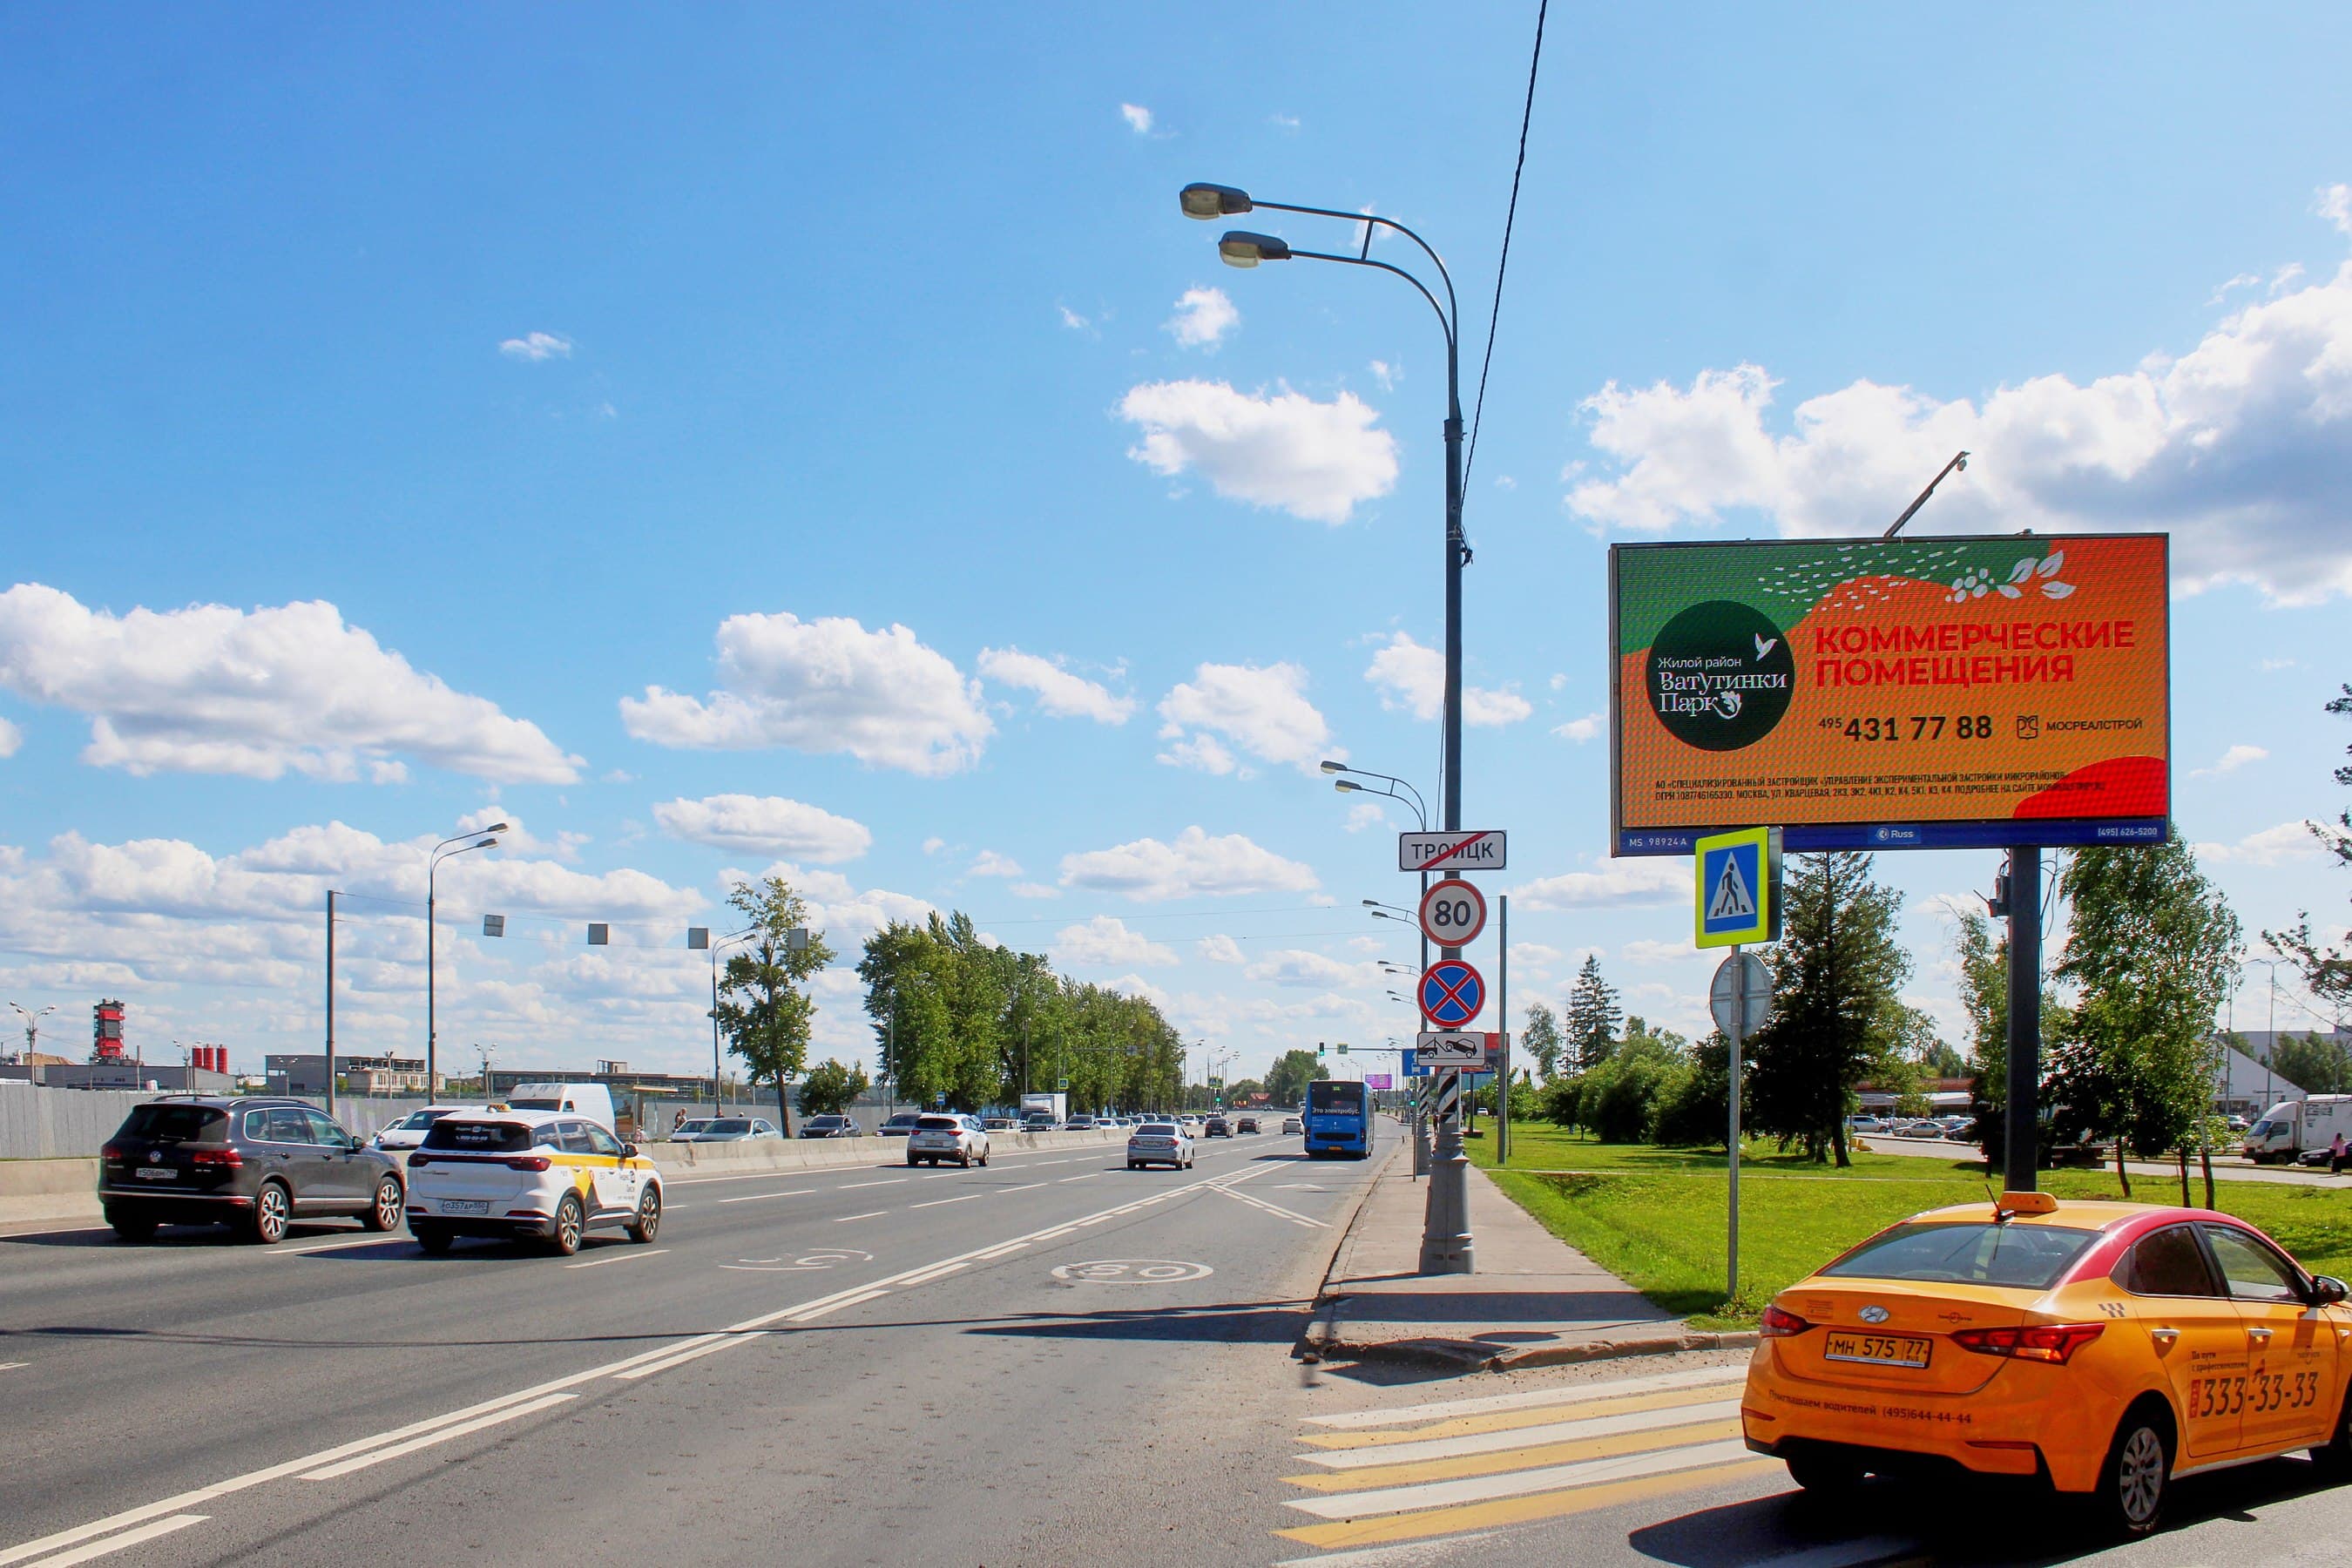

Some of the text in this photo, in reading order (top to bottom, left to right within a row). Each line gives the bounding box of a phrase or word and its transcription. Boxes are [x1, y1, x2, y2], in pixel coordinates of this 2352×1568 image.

[1815, 620, 2135, 654] КОММЕРЧЕСКИЕ
[1658, 656, 1742, 671] Жилой район
[1816, 654, 2074, 688] ПОМЕЩЕНИЯ
[1659, 672, 1788, 695] Ватутинки
[1659, 693, 1719, 717] Парк
[1818, 715, 1992, 741] 495 431 77 88
[2045, 718, 2143, 732] МОСРЕАЛСТРОЙ
[1767, 775, 1818, 787] ЗАСТРОЙЩИК
[1873, 772, 1957, 784] ЭКСПЕРИМЕНТАЛЬНОЙ
[1959, 771, 2003, 782] ЗАСТРОЙКИ
[1655, 791, 1675, 801] ОГРН
[1955, 784, 1999, 795] ПОДРОБНЕЕ
[2000, 784, 2011, 794] НА
[2012, 782, 2035, 794] САЙТЕ
[1890, 829, 1914, 838] Russ
[2119, 827, 2158, 836] 626-5200
[1411, 841, 1494, 862] ТРОИЦК
[1629, 838, 1643, 847] MS
[1434, 900, 1471, 927] 80
[1834, 1338, 1924, 1358] МН 575 77
[1769, 1389, 1821, 1409] Приглашаем
[1823, 1402, 1876, 1416] водителей
[2200, 1371, 2319, 1418] 333-33-33
